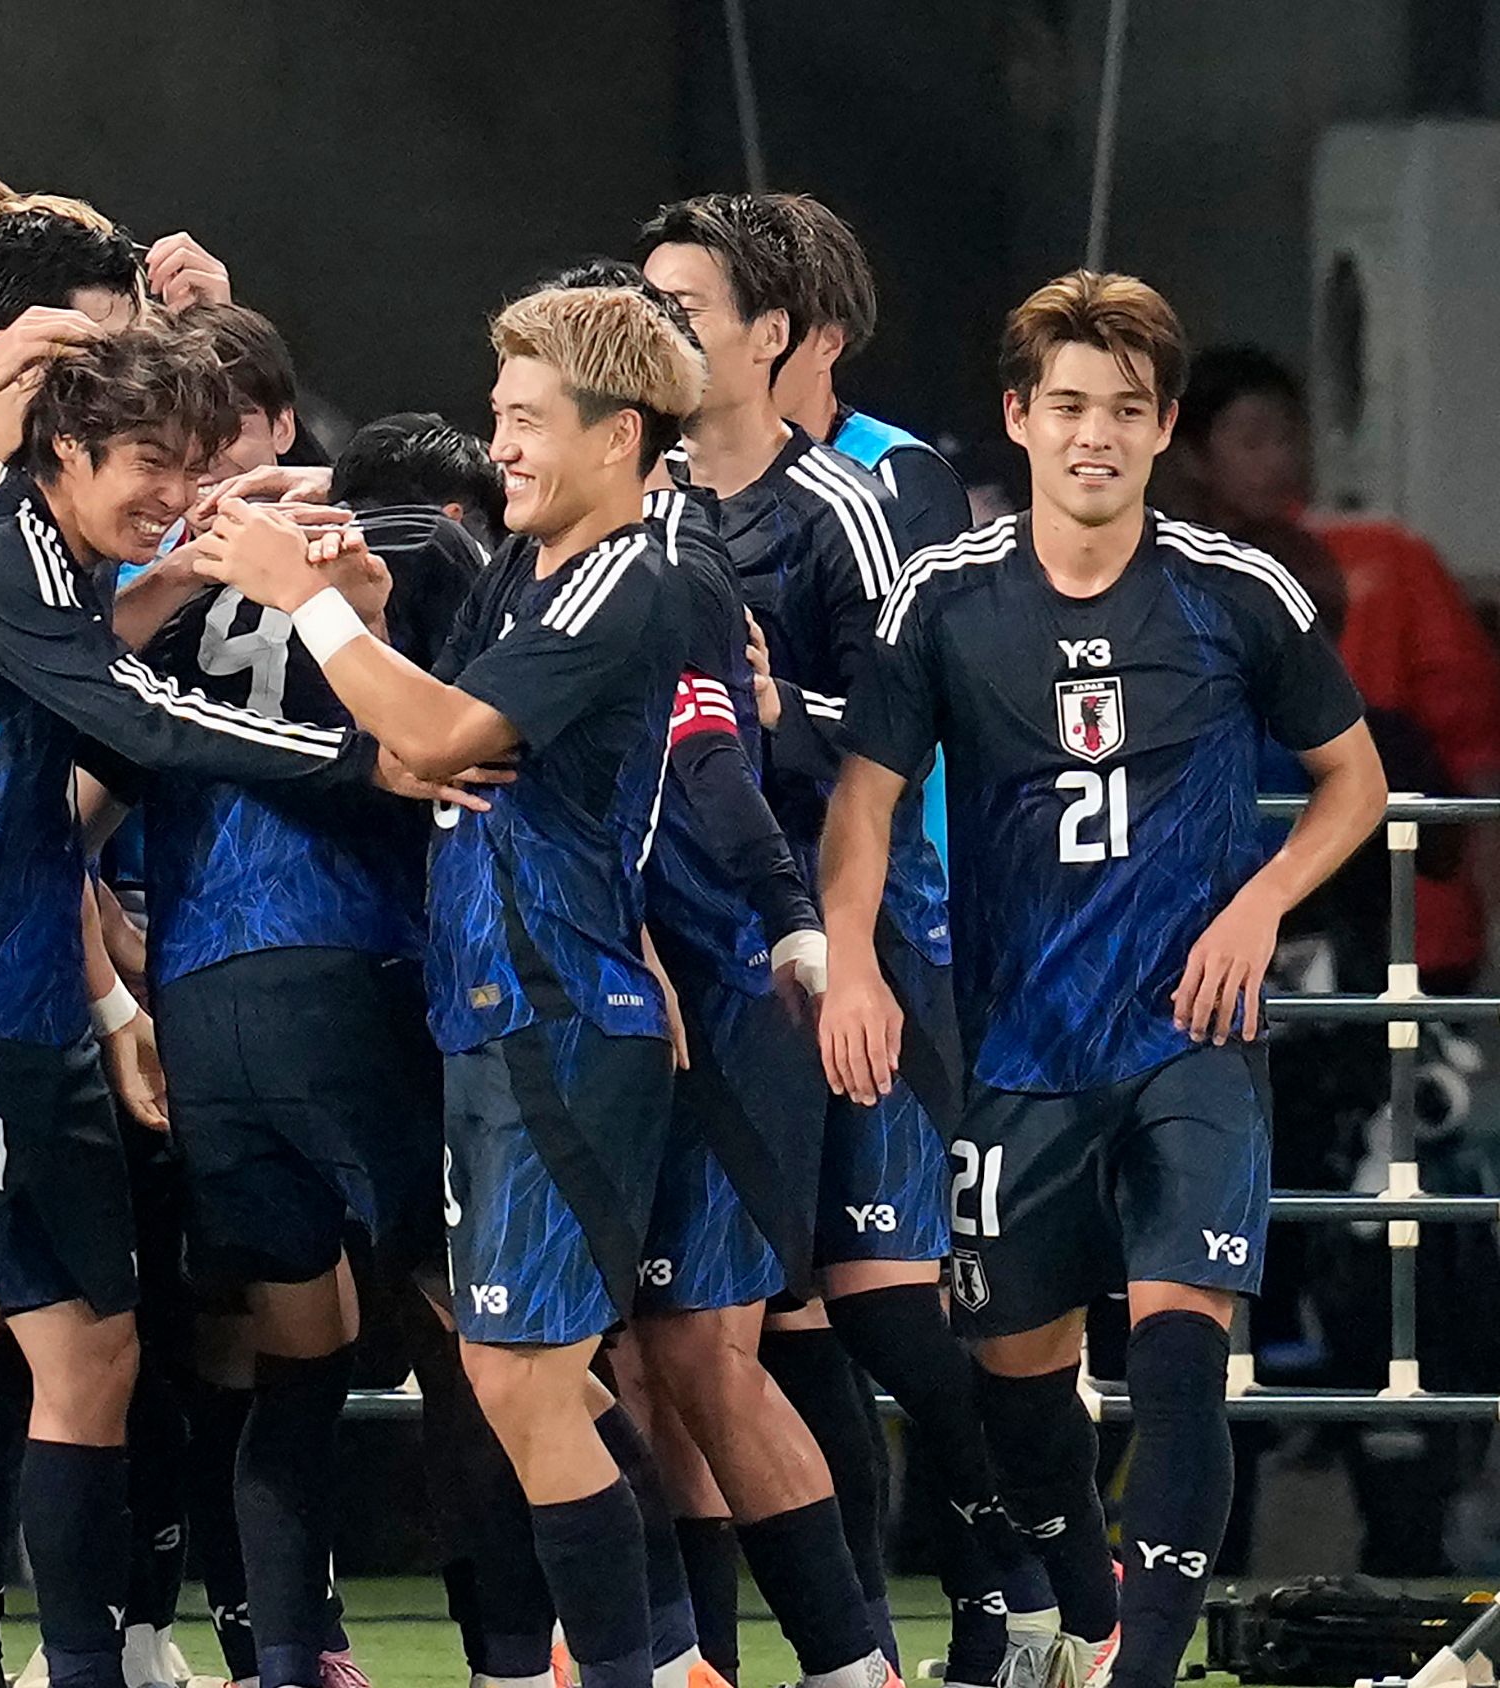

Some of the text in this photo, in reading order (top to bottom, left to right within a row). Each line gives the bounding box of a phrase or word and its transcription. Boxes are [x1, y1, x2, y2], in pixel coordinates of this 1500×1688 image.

[1057, 638, 1112, 669] Y-3
[1072, 683, 1105, 693] JAPAN
[1055, 766, 1130, 864] 21
[950, 1139, 1003, 1237] 21
[845, 1203, 898, 1233] Y-3
[1202, 1229, 1248, 1265] Y-3
[636, 1258, 673, 1287] Y-3
[470, 1284, 509, 1314] Y-3
[1136, 1541, 1208, 1579] Y-3
